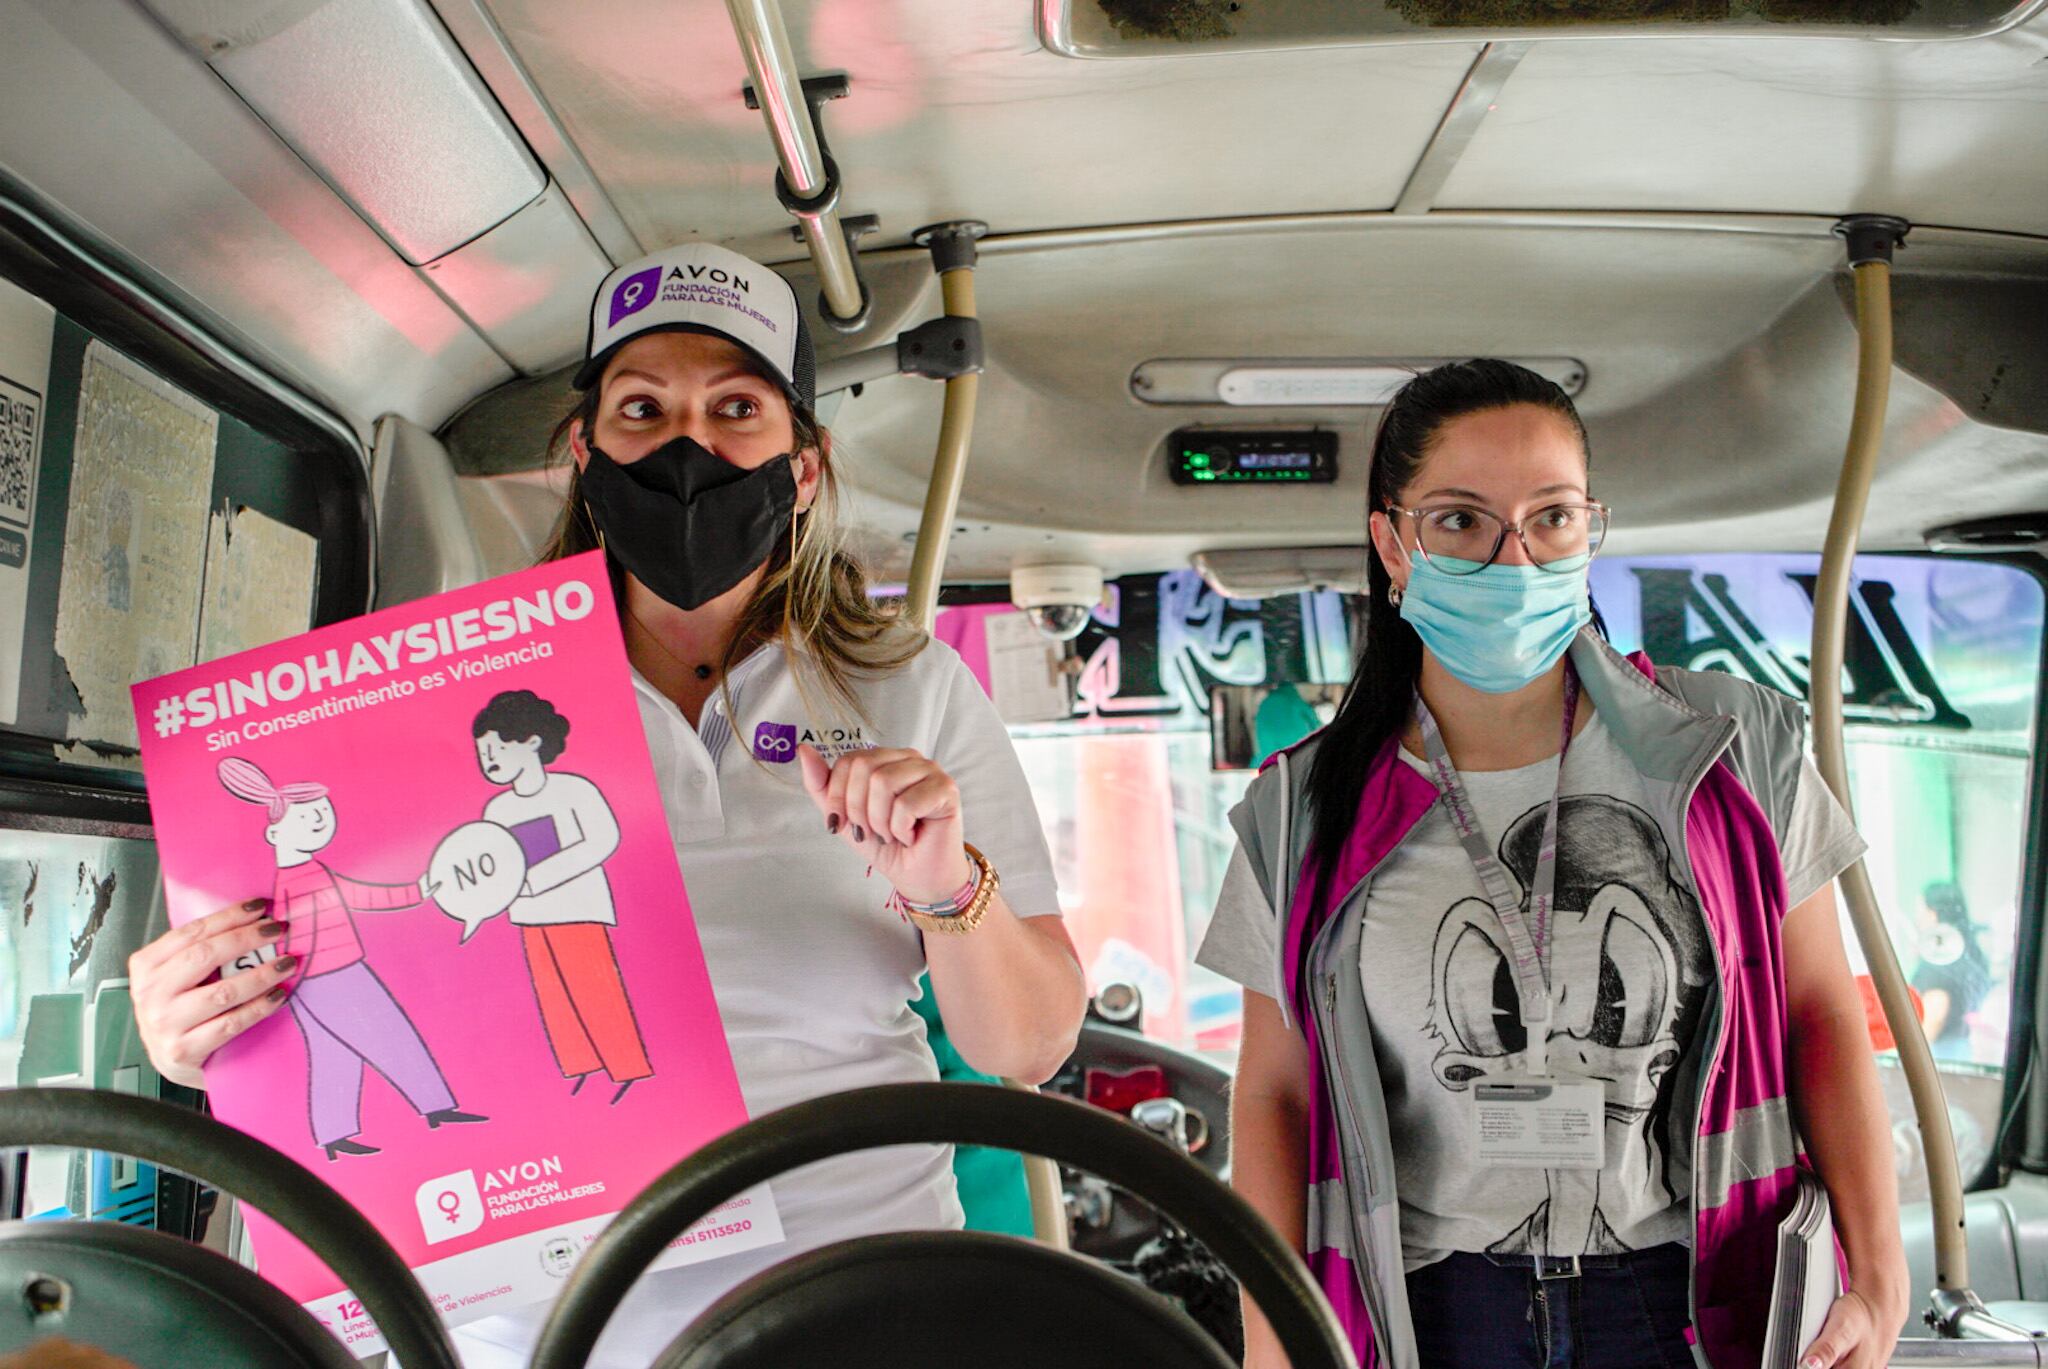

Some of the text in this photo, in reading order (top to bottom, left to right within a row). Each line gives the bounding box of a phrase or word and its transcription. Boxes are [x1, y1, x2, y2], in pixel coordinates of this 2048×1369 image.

[663, 283, 741, 302] FUNDACIÓN
[666, 265, 750, 293] AVON
[661, 293, 777, 332] PARA LAS MUJERES
[153, 580, 595, 739] #SINOHAYSIESNO
[206, 639, 554, 753] Sin Consentimiento es Violencia
[453, 852, 496, 892] NO
[483, 1155, 563, 1192] AVON
[487, 1180, 560, 1209] FUNDACIÓN
[490, 1181, 606, 1219] PARA LAS MUJERES
[667, 1219, 752, 1249] ansi 5113520
[337, 1299, 366, 1321] 12
[355, 1328, 381, 1342] Muje
[444, 1301, 458, 1312] de
[458, 1284, 513, 1307] Violencias
